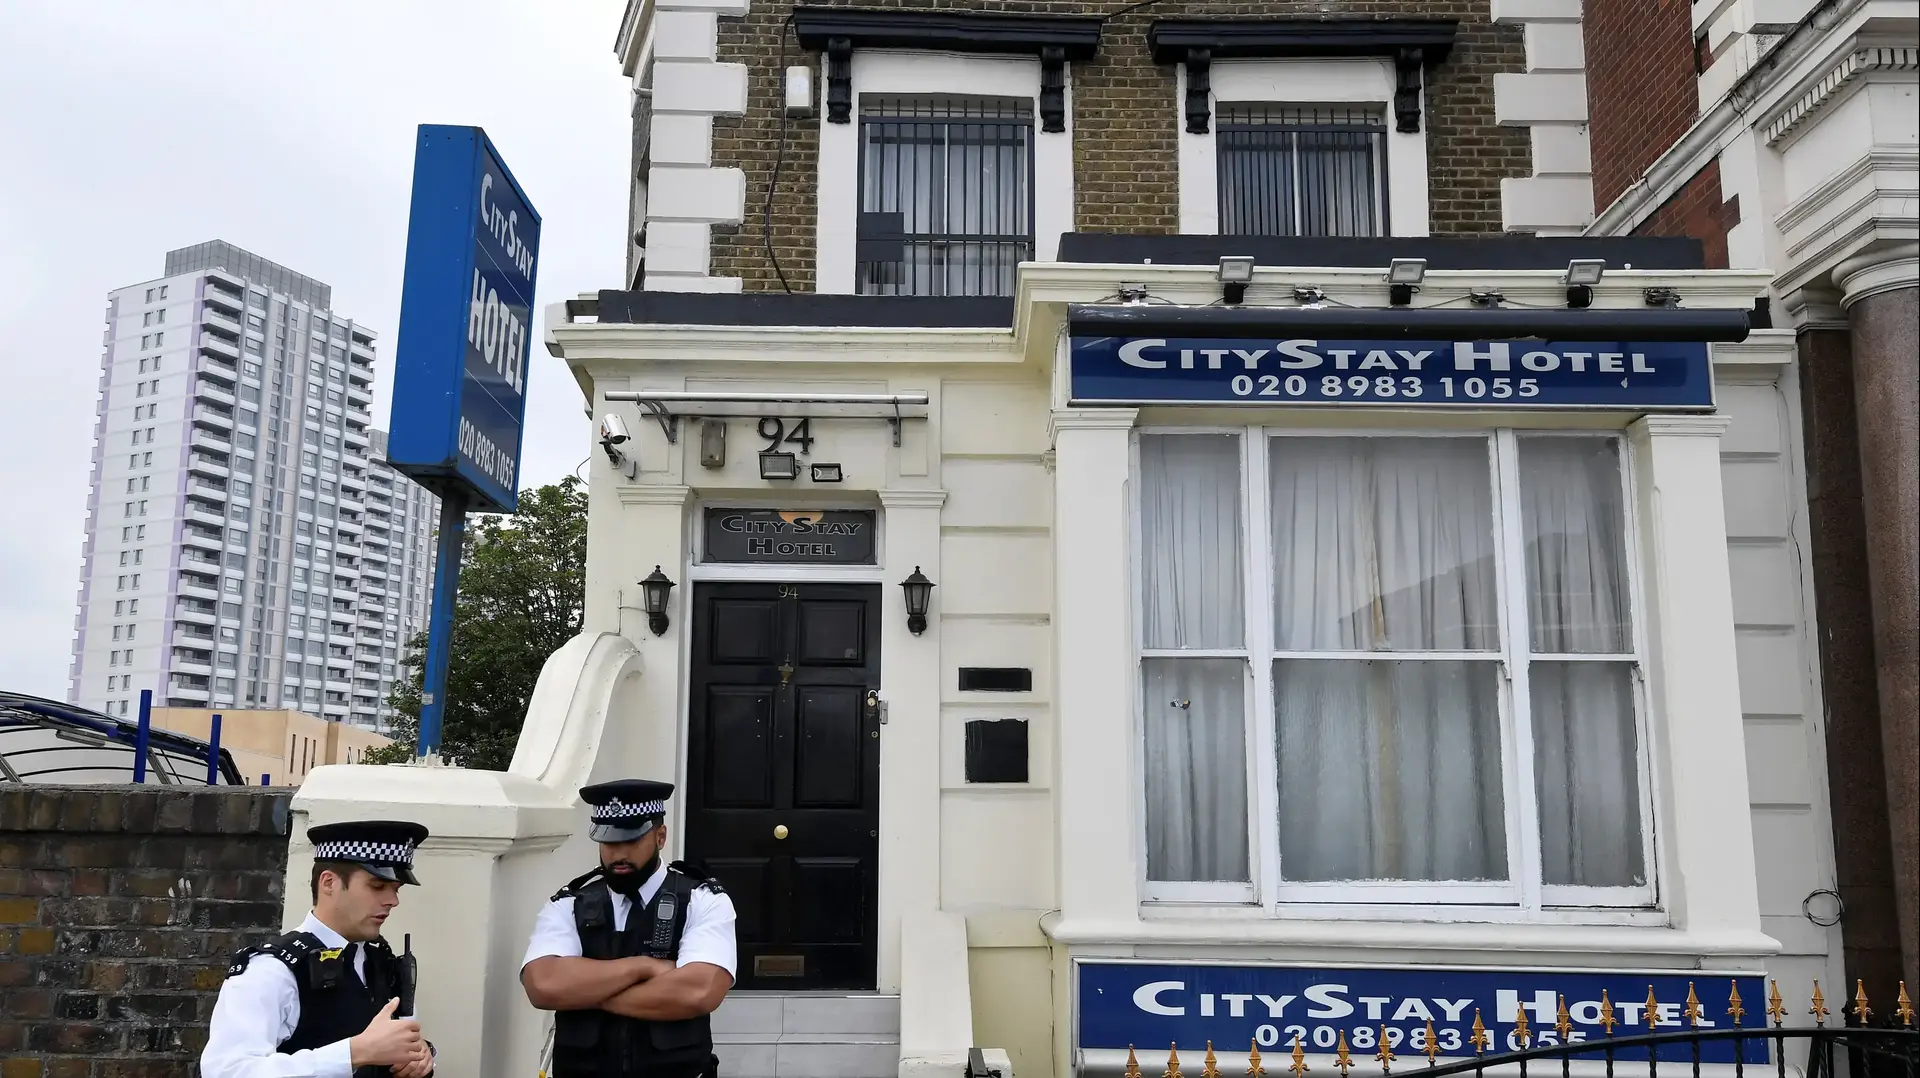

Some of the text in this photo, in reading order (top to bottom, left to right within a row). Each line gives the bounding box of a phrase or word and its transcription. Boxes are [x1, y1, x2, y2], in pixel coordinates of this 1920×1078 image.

[468, 266, 525, 397] HOTEL
[1453, 342, 1656, 373] HOTEL
[1231, 375, 1540, 398] 020 8983 1055
[757, 417, 815, 454] 94
[458, 416, 515, 491] 020 8983 1055
[747, 538, 837, 556] HOTEL
[778, 584, 799, 600] 94
[280, 949, 298, 964] 759
[1496, 989, 1716, 1028] HOTEL
[1255, 1024, 1337, 1048] 020
[1352, 1026, 1463, 1051] 8983
